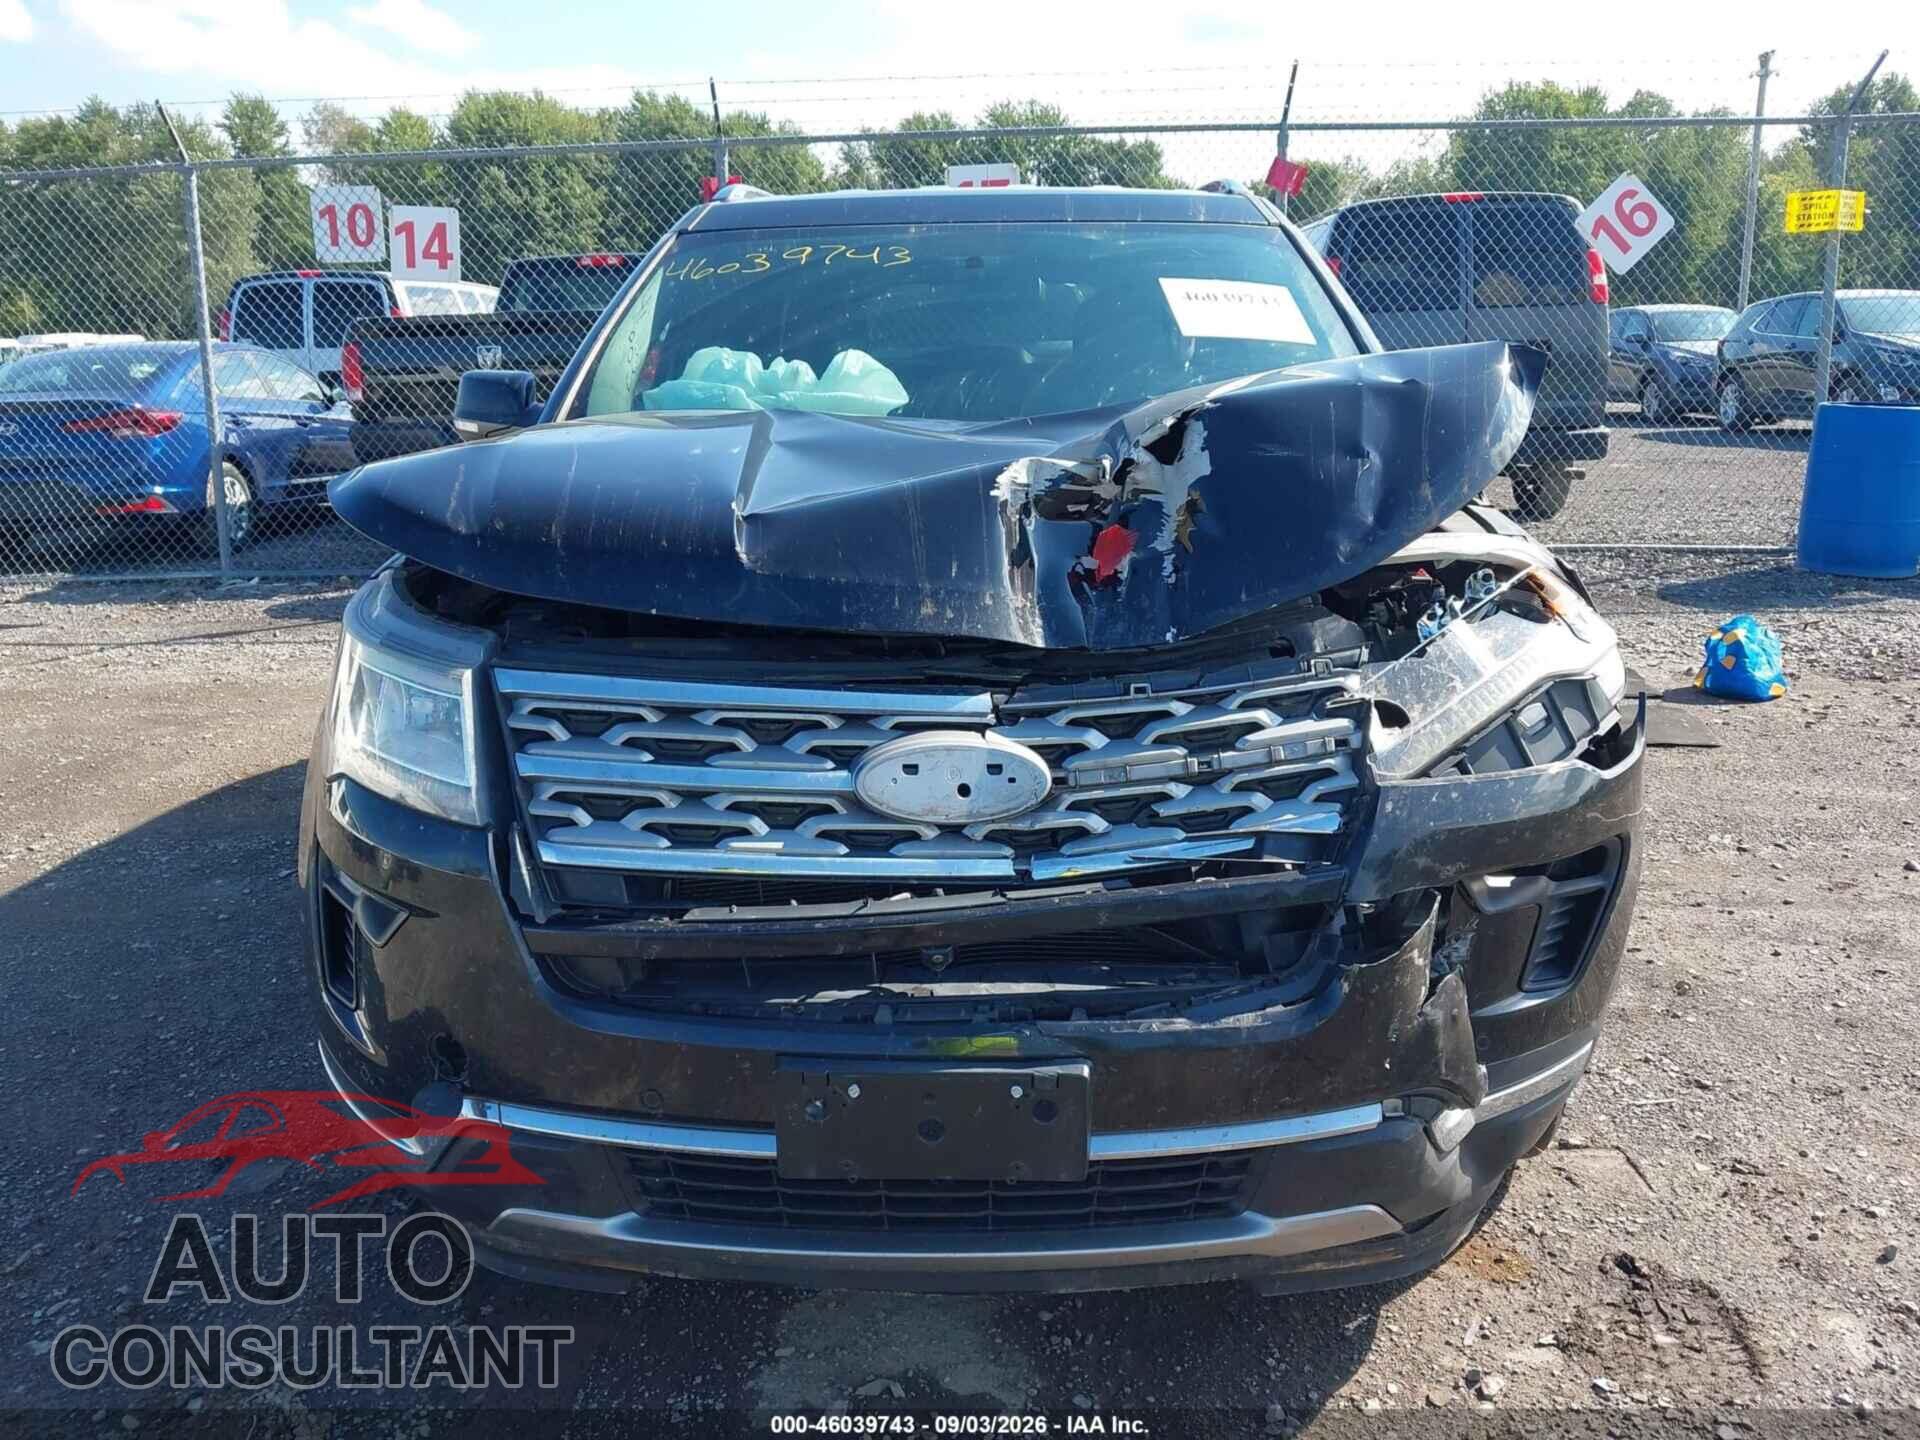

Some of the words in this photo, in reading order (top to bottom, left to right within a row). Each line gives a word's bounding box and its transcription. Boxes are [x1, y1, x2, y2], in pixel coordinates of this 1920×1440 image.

[318, 203, 376, 248] 10
[1591, 188, 1658, 255] 16
[1796, 212, 1835, 221] STATION
[1802, 202, 1828, 211] SPILL
[394, 220, 454, 271] 14
[664, 245, 913, 281] 46039743
